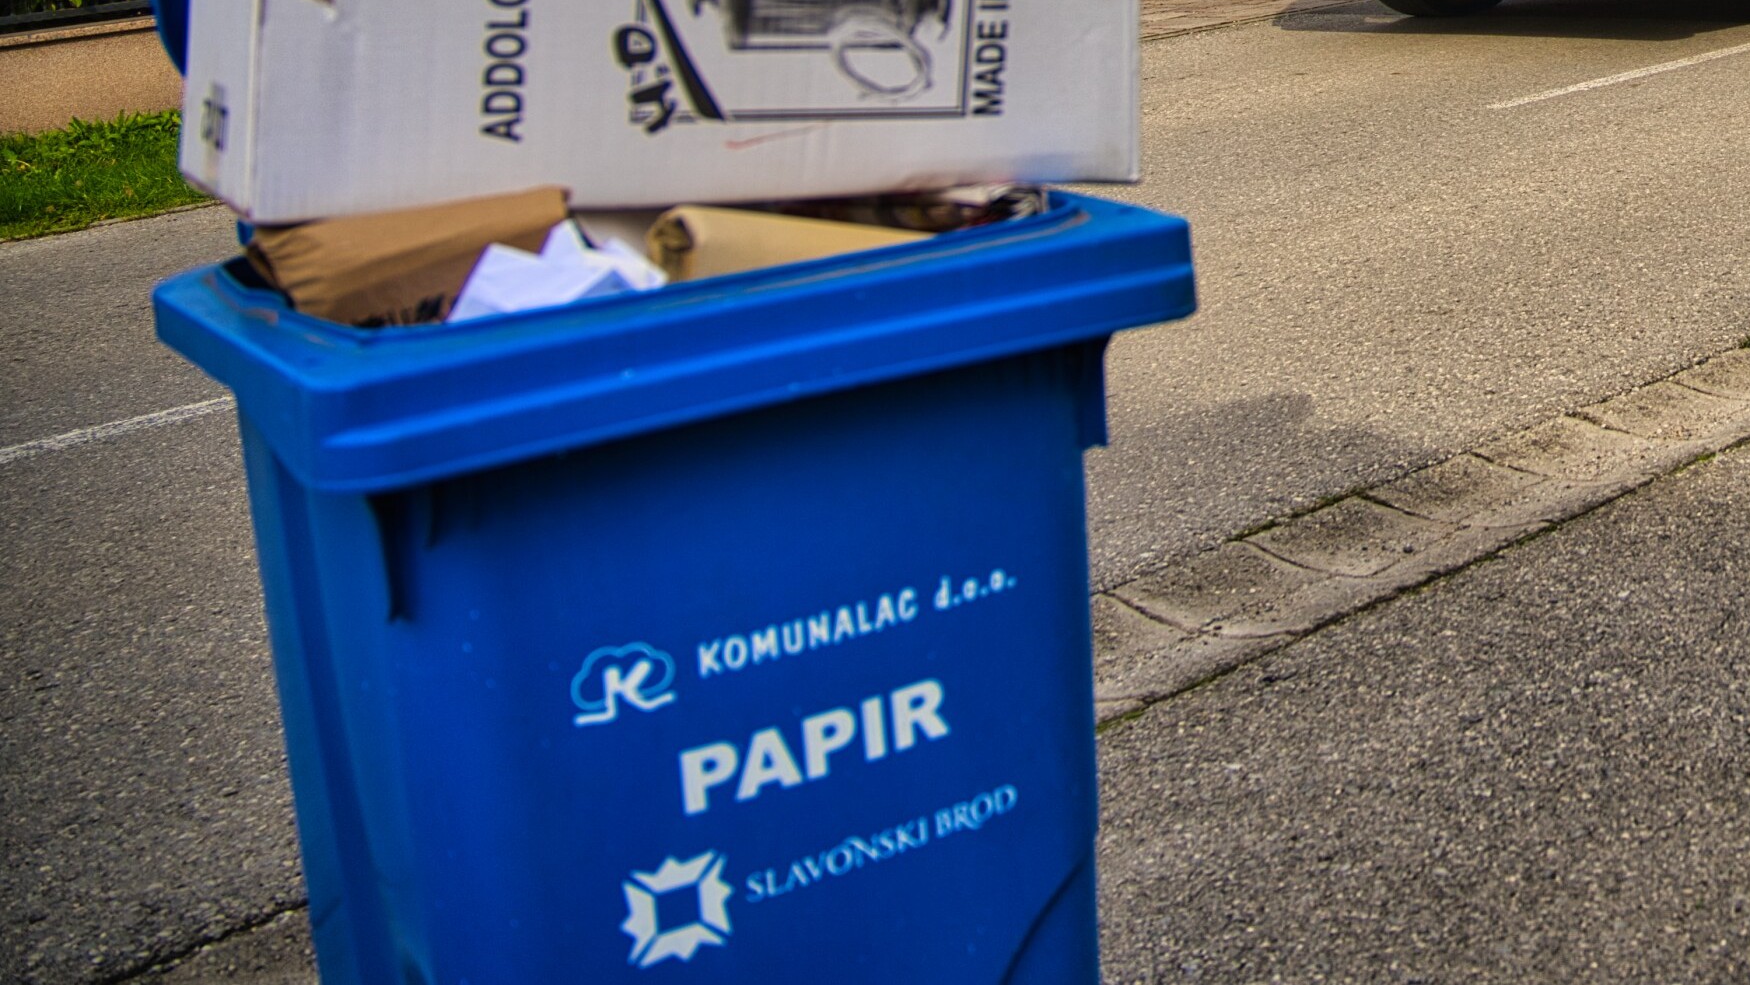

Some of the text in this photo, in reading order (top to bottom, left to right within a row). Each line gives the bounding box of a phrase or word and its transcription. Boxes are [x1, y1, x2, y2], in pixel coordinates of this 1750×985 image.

[973, 20, 1010, 117] MADE
[697, 586, 919, 679] KOMUNALAC
[932, 568, 1018, 610] d.o.o.
[679, 678, 951, 815] PAPIR
[746, 784, 1019, 903] SLAVONSKI BROD
